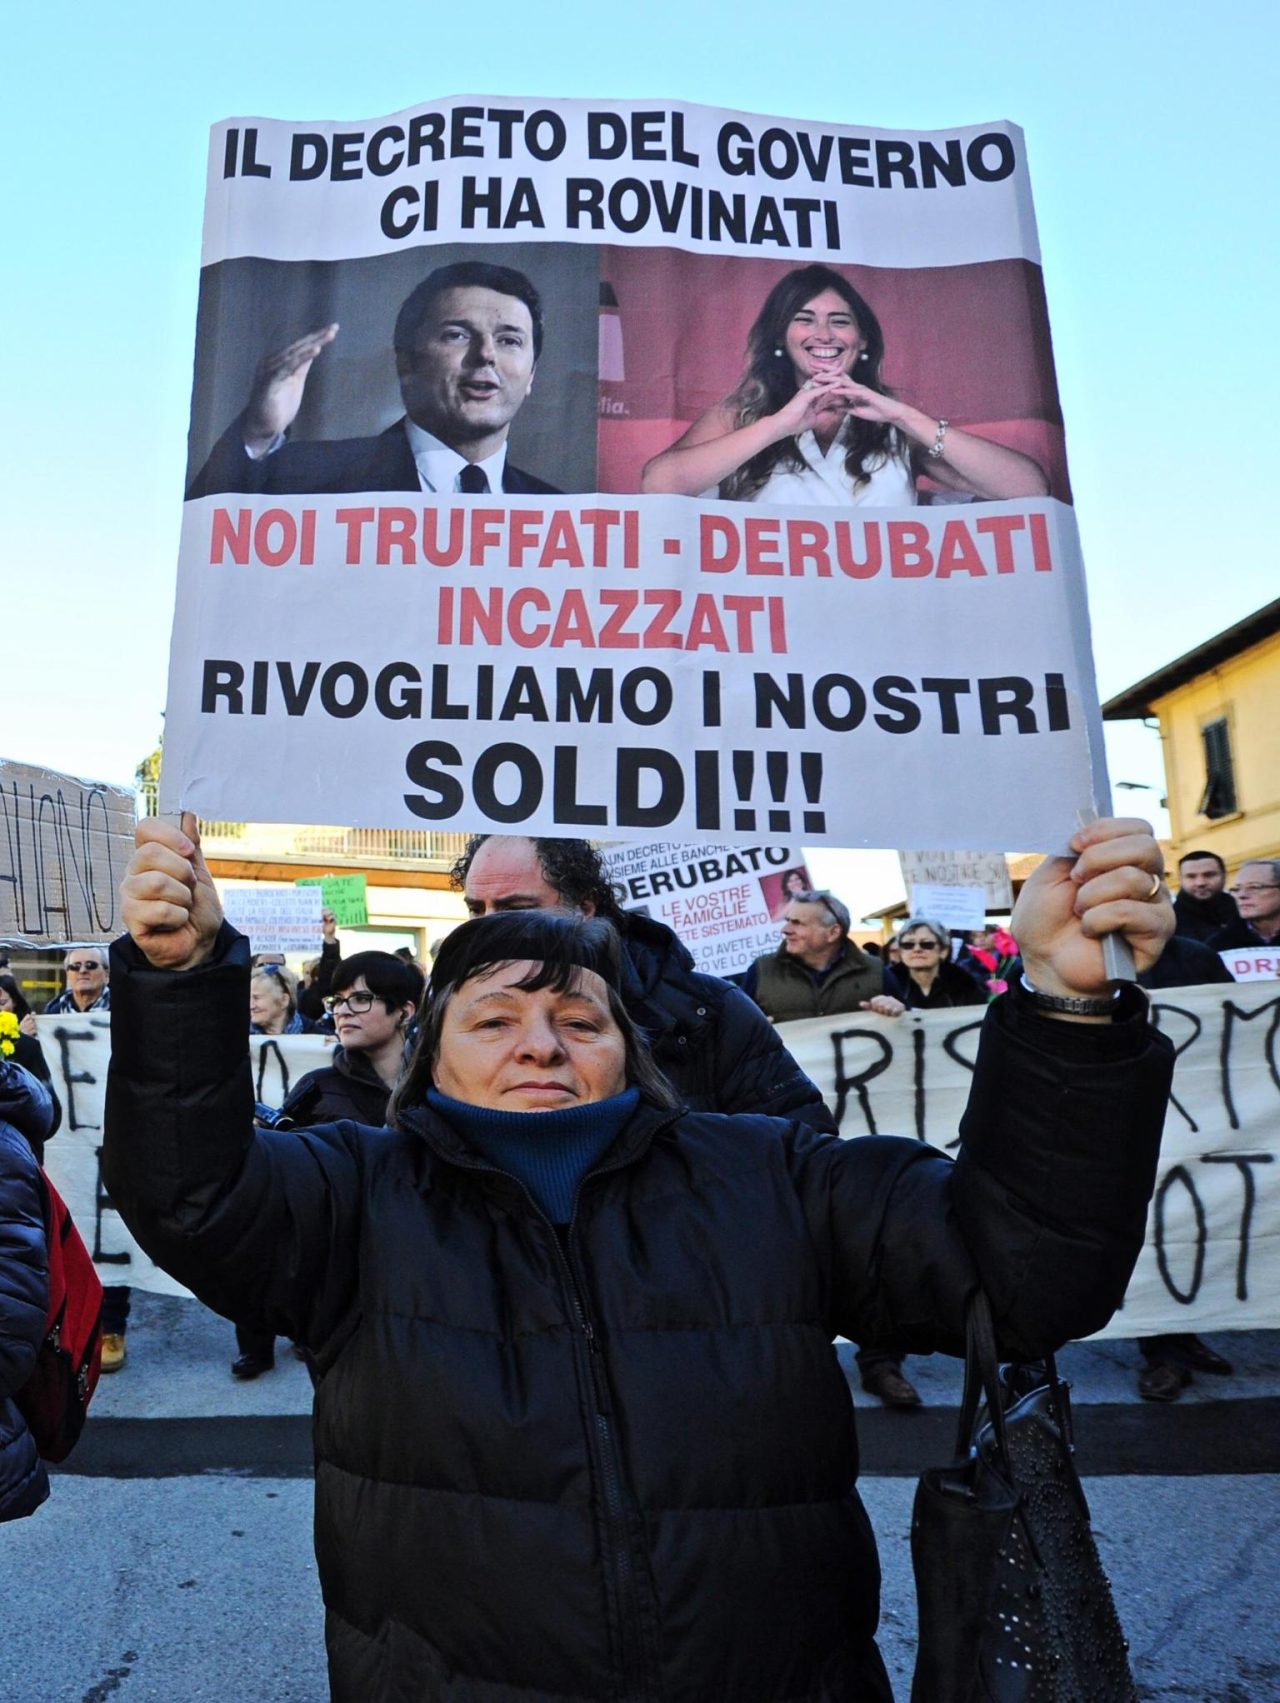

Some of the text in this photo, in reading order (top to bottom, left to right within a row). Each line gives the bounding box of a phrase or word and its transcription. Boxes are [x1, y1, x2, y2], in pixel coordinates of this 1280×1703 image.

[223, 107, 1016, 190] IL DECRETO DEL GOVERNO
[380, 177, 841, 250] CI HA ROVINATI
[209, 508, 314, 567] NOI
[336, 508, 638, 573] TRUFFATI
[700, 513, 1054, 581] DERUBATI
[436, 585, 788, 655] INCAZZATI
[201, 659, 1070, 737] RIVOGLIAMO I NOSTRI
[404, 739, 826, 834] SOLDI!!!
[613, 847, 790, 902] DERUBATO
[650, 857, 679, 873] ALLE
[661, 884, 752, 918] LE VOSTRE
[673, 901, 748, 929] FAMIGLIE
[702, 912, 769, 938] SISTEMATO
[717, 934, 754, 954] AVETE
[711, 957, 730, 971] VE
[731, 953, 748, 968] LO
[1234, 958, 1280, 974] DR
